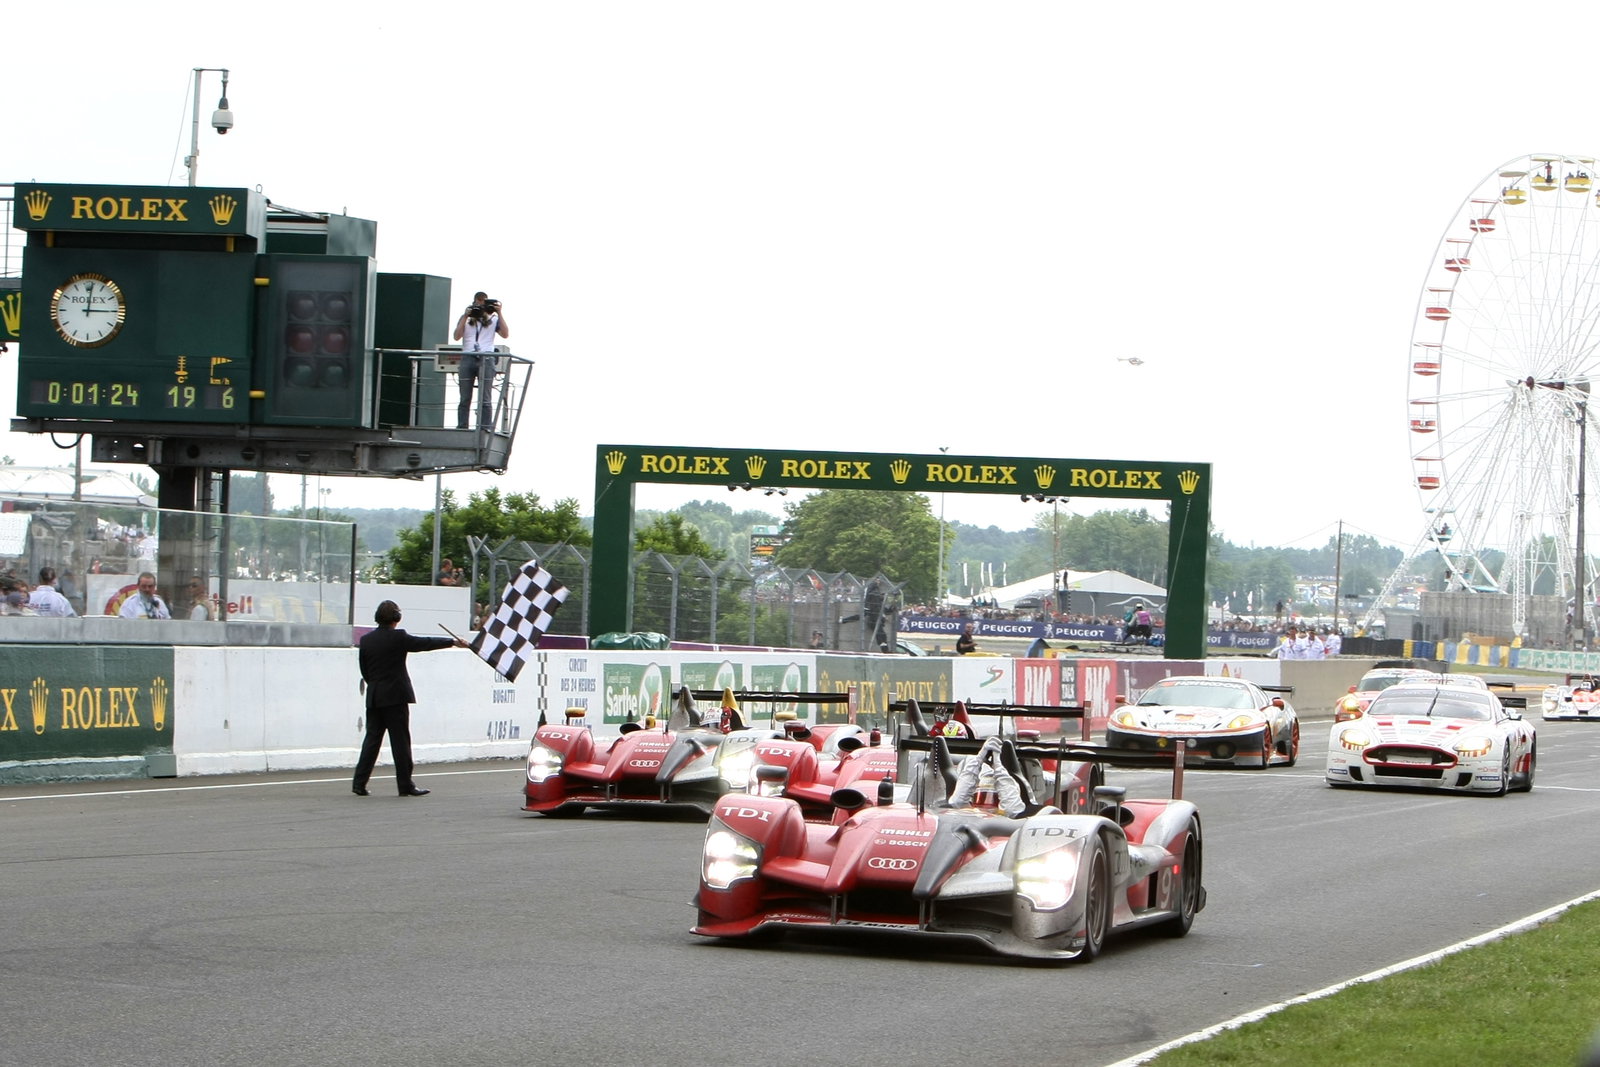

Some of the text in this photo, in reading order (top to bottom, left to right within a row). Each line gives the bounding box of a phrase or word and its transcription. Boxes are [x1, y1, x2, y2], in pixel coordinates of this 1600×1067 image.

[71, 196, 188, 222] ROLEX
[71, 296, 106, 304] ROLEX
[210, 377, 230, 385] km/h
[48, 382, 139, 406] 0:01:24
[168, 385, 196, 408] 19
[222, 387, 235, 409] 6
[640, 454, 730, 475] ROLEX
[781, 459, 871, 480] ROLEX
[926, 463, 1017, 485] ROLEX
[1070, 468, 1162, 490] ROLEX
[910, 621, 961, 631] PEUGEOT
[982, 624, 1033, 634] PEUGEOT
[1055, 627, 1105, 638] PEUGEOT
[1237, 637, 1270, 647] PEUGEOT
[578, 678, 596, 692] HEURES
[493, 689, 516, 704] BUGATTI
[606, 685, 638, 717] Sarthe
[61, 687, 140, 730] ROLEX
[487, 719, 520, 742] 4,185 km
[540, 731, 571, 742] TDI
[728, 736, 758, 744] TDI
[758, 747, 793, 757] TDI
[1071, 788, 1079, 815] 8
[721, 806, 773, 823] TDI
[880, 828, 931, 837] MAHLE
[1027, 827, 1079, 839] TDI
[888, 839, 928, 847] BOSCH
[1161, 867, 1172, 910] 9
